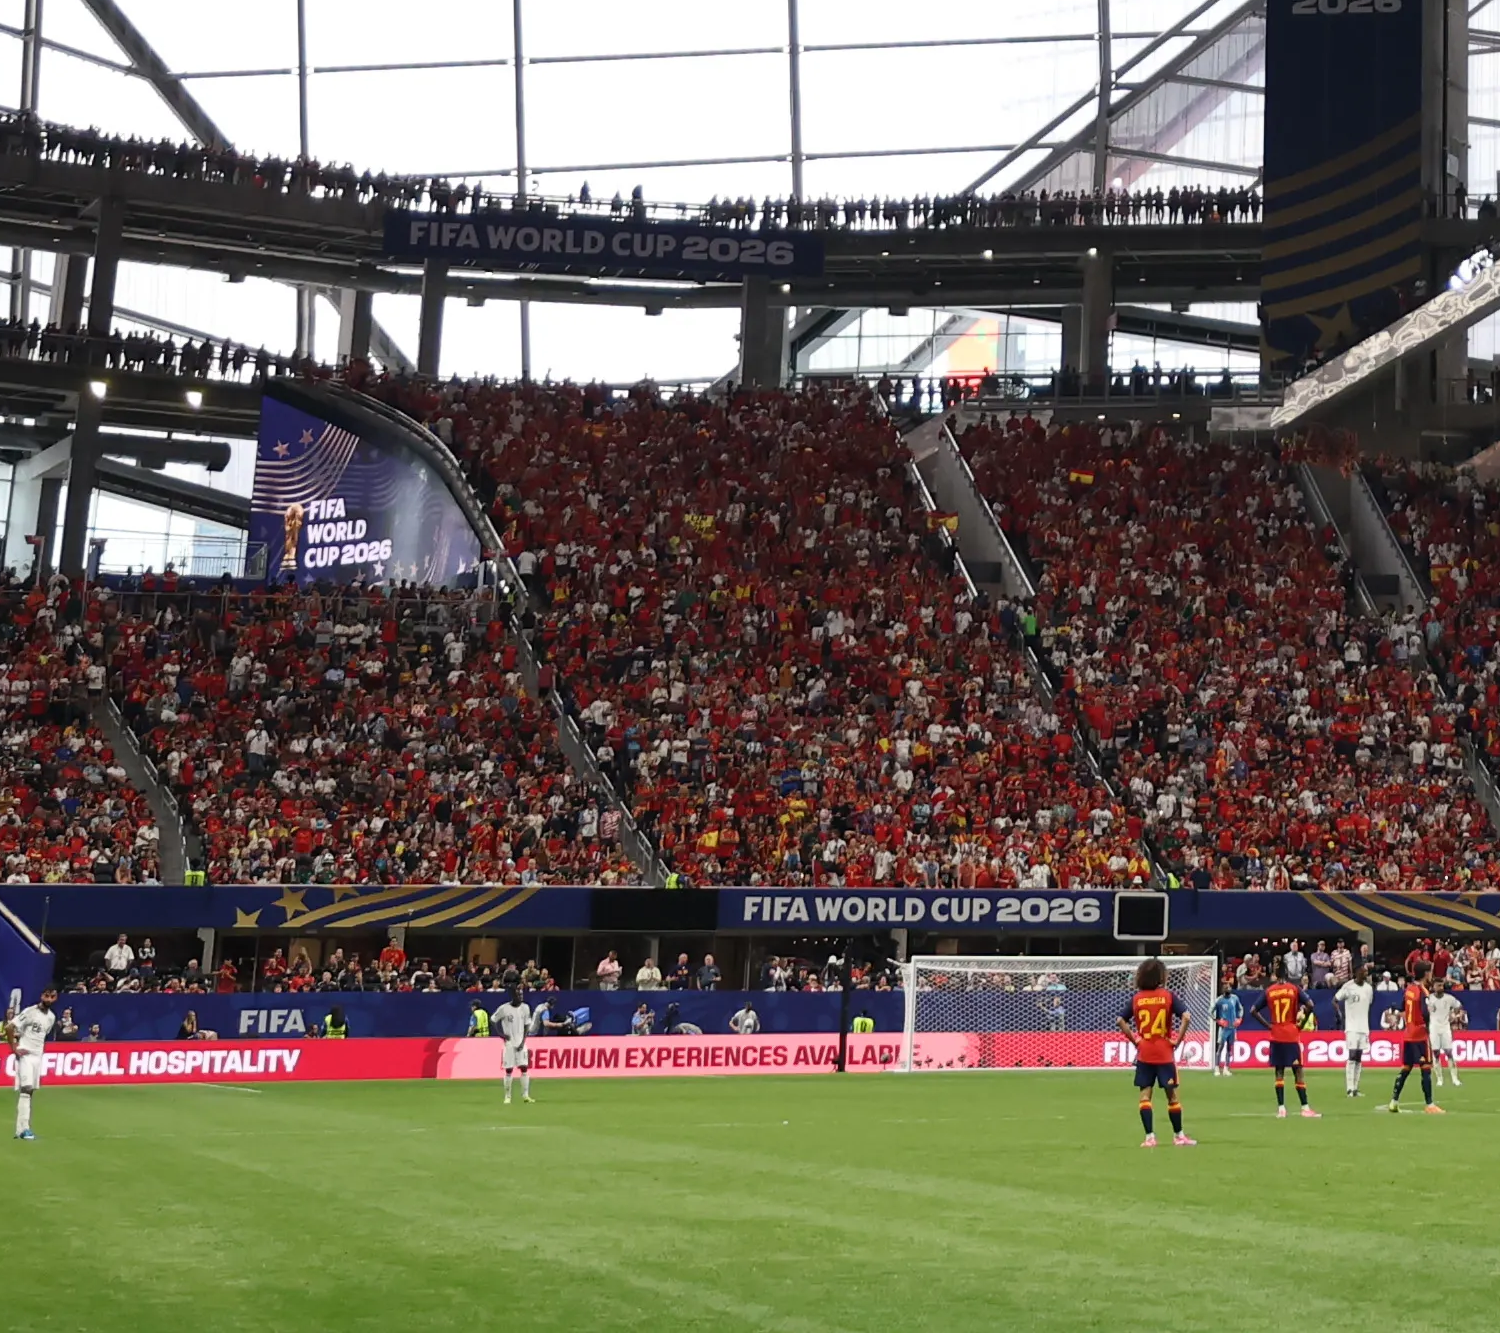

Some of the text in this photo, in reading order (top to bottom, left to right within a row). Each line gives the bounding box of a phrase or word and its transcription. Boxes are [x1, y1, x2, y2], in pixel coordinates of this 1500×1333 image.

[409, 220, 794, 265] FIFA WORLD CUP 2026
[309, 497, 345, 521] FIFA
[306, 520, 367, 543] WORLD
[304, 539, 392, 568] CUP 2026
[743, 895, 1100, 923] FIFA WORLD CUP 2026
[239, 1009, 305, 1033] FIFA
[1274, 998, 1291, 1023] 17
[1138, 1009, 1167, 1039] 24
[6, 1047, 123, 1077] FICIAL
[128, 1048, 301, 1076] HOSPITALITY
[501, 1044, 920, 1070] EMIUM EXPERIENCES AVALABL
[1308, 1040, 1392, 1062] 206
